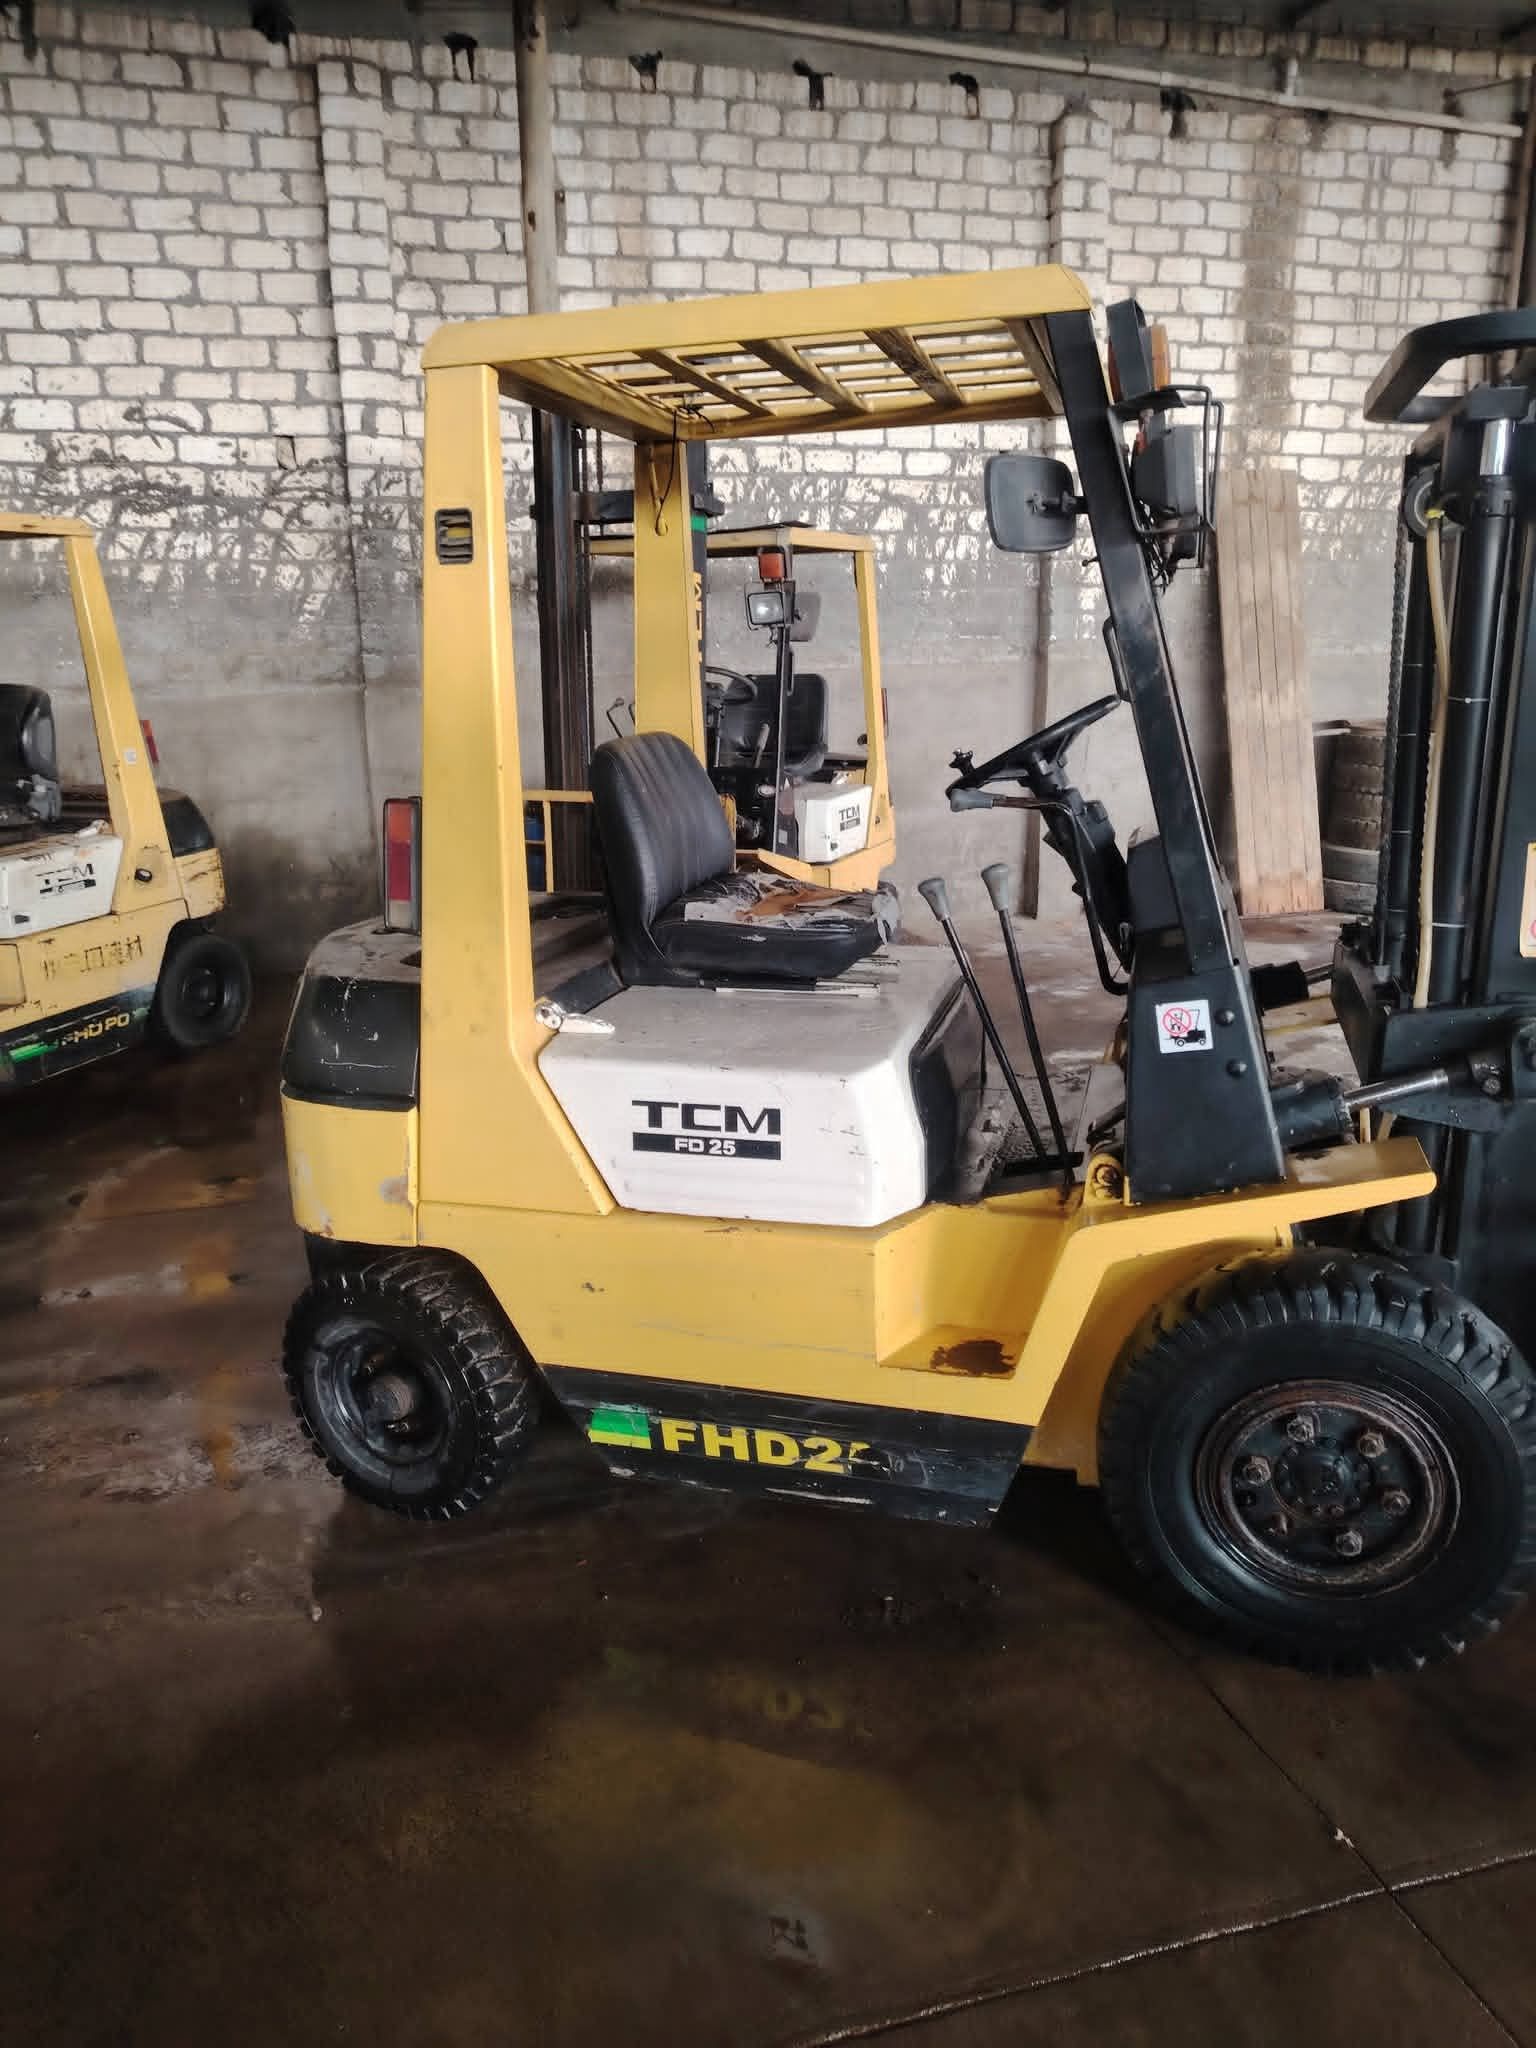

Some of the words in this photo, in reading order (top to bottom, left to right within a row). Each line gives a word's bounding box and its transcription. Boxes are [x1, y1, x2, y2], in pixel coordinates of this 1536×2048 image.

[839, 804, 860, 821] TCM
[632, 1100, 781, 1136] TCM
[674, 1137, 705, 1153] FD
[709, 1140, 736, 1156] 25
